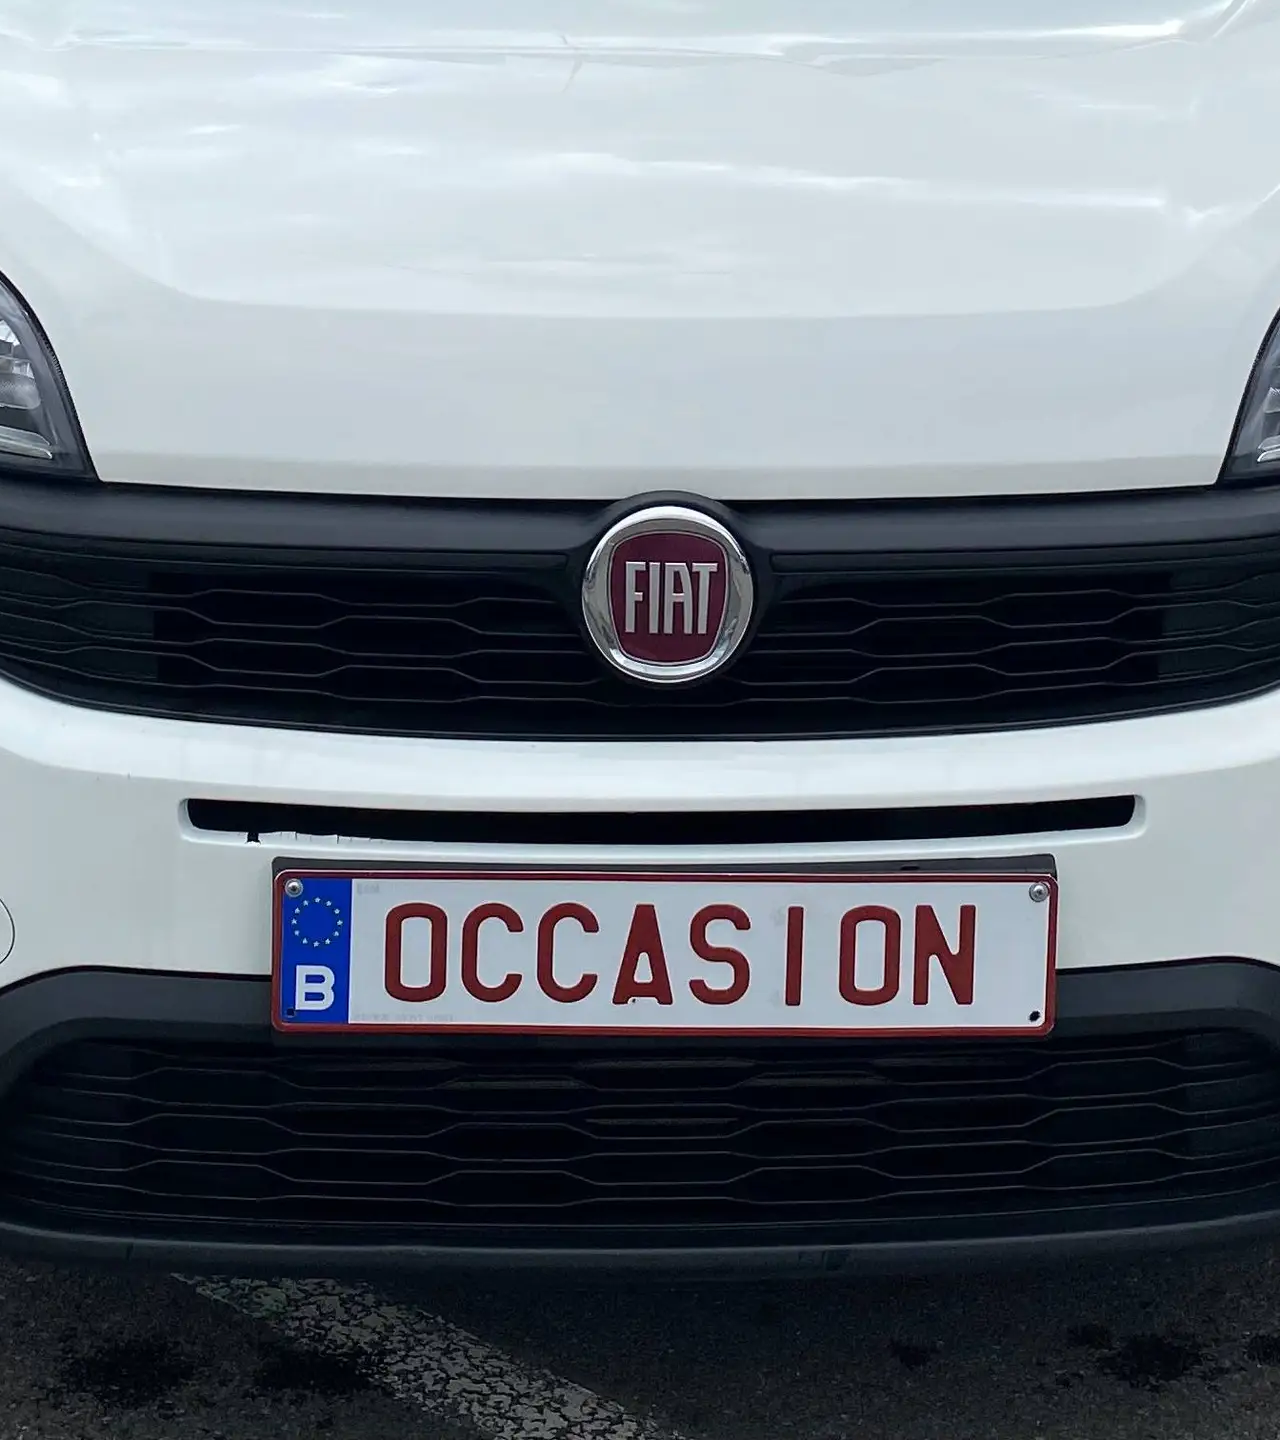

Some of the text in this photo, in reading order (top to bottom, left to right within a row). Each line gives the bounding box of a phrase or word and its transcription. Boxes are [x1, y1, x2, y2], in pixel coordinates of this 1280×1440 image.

[625, 561, 718, 636] FIAT
[295, 964, 336, 1011] B
[384, 902, 976, 1007] OCCASION
